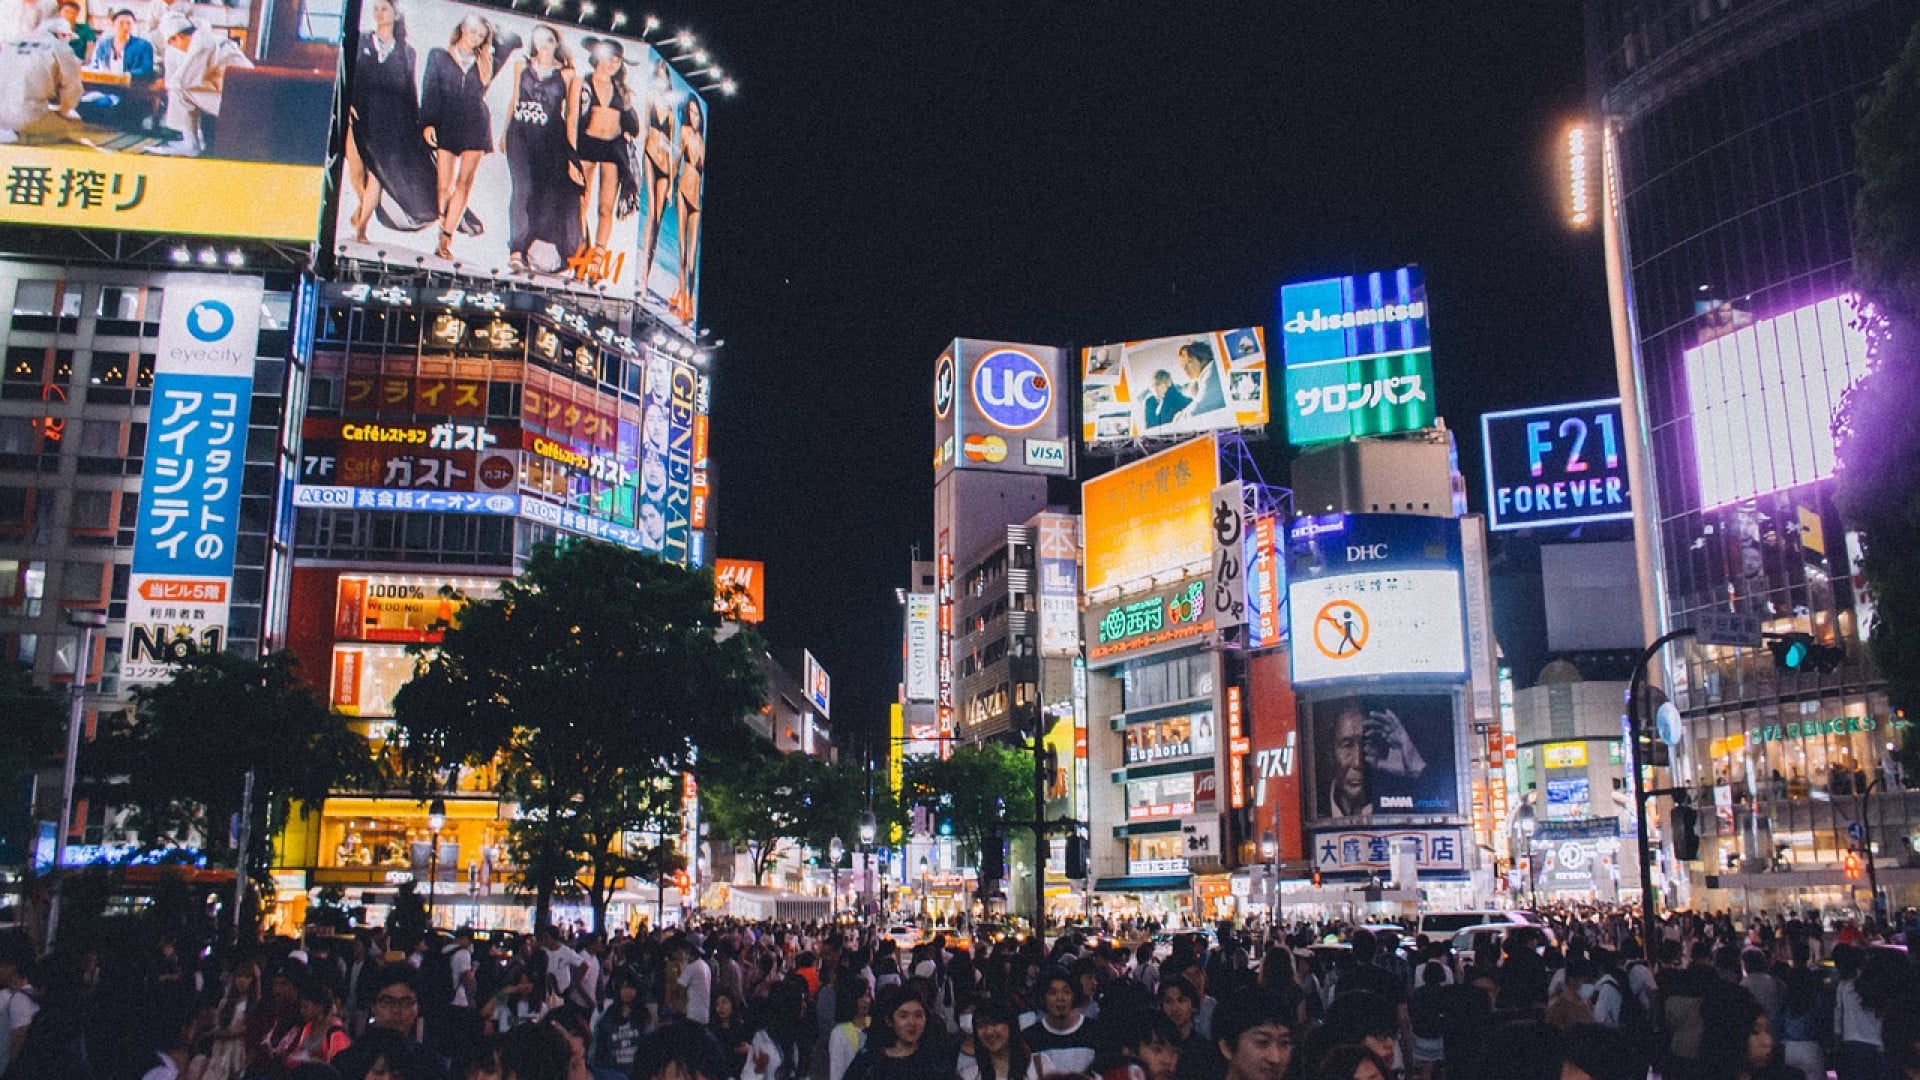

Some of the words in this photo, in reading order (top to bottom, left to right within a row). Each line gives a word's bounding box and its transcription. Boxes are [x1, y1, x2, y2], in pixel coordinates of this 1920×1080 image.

[4, 165, 148, 211] 番搾り
[1284, 302, 1424, 333] Hisamitsu
[170, 345, 242, 365] eyecity
[348, 379, 479, 407] プライス
[1295, 375, 1426, 416] サロンパス
[523, 388, 614, 441] コンタクト
[430, 422, 498, 450] ガスト
[1526, 413, 1618, 478] F21
[1031, 446, 1063, 460] VISA
[150, 389, 203, 560] アイシティ
[195, 392, 238, 561] コンタクトの
[303, 456, 336, 475] 7F
[384, 456, 468, 487] ガスト
[299, 488, 348, 503] AEON
[358, 488, 482, 511] 英会話イーオン
[524, 501, 557, 520] AEON
[1497, 476, 1623, 516] FOREVER
[1346, 543, 1388, 562] DHC
[149, 583, 220, 599] 当ビル5階
[369, 584, 424, 600] 1000%
[1126, 606, 1162, 637] 西村
[1751, 715, 1876, 745] STARBUCKS
[1130, 742, 1190, 763] Euphoria
